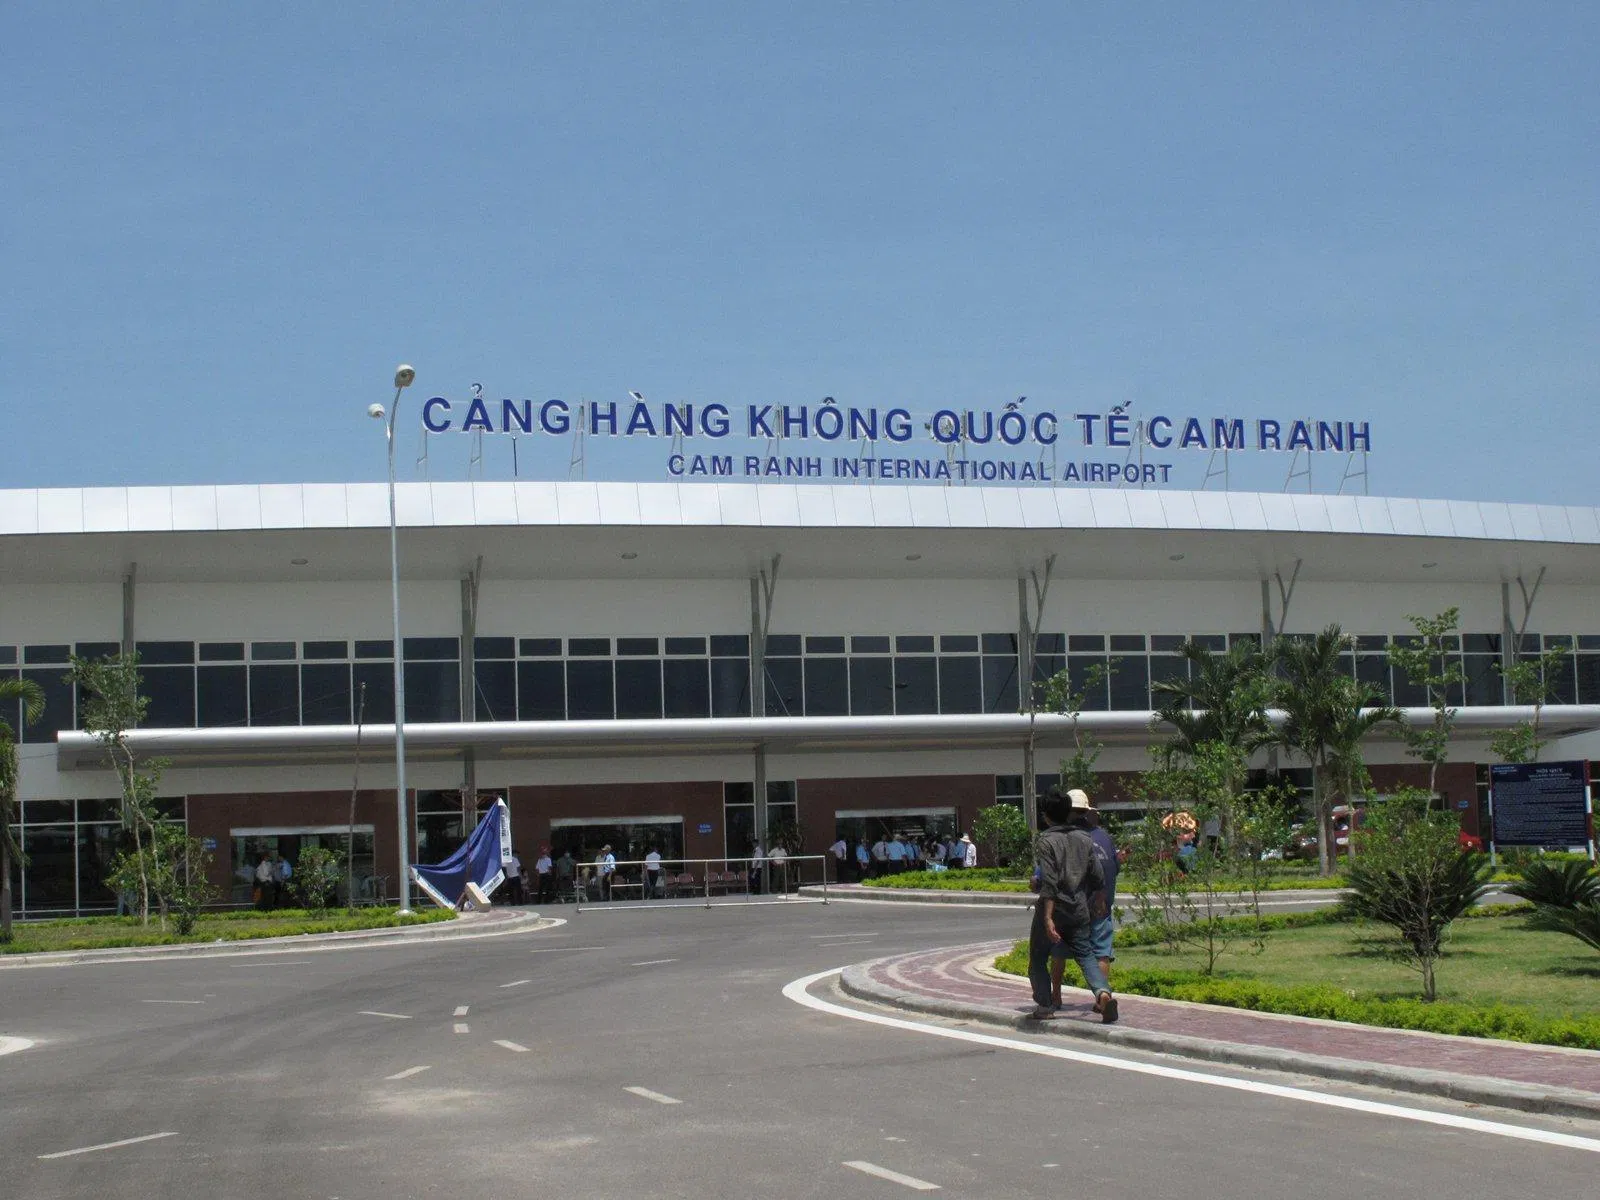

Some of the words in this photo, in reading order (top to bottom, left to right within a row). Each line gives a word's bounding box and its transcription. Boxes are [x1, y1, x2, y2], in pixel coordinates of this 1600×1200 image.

[422, 383, 570, 435] CẢNG
[588, 391, 729, 438] HÀNG
[747, 396, 912, 441] KHÔNG
[932, 397, 1058, 446] QUỐC
[1076, 401, 1131, 447] TẾ
[1146, 415, 1246, 450] CAM
[1259, 419, 1371, 453] RANH
[668, 454, 733, 476] CAM
[745, 455, 822, 477] RANH
[833, 457, 1052, 481] INTERNATIONAL
[1064, 463, 1173, 483] AIRPORT
